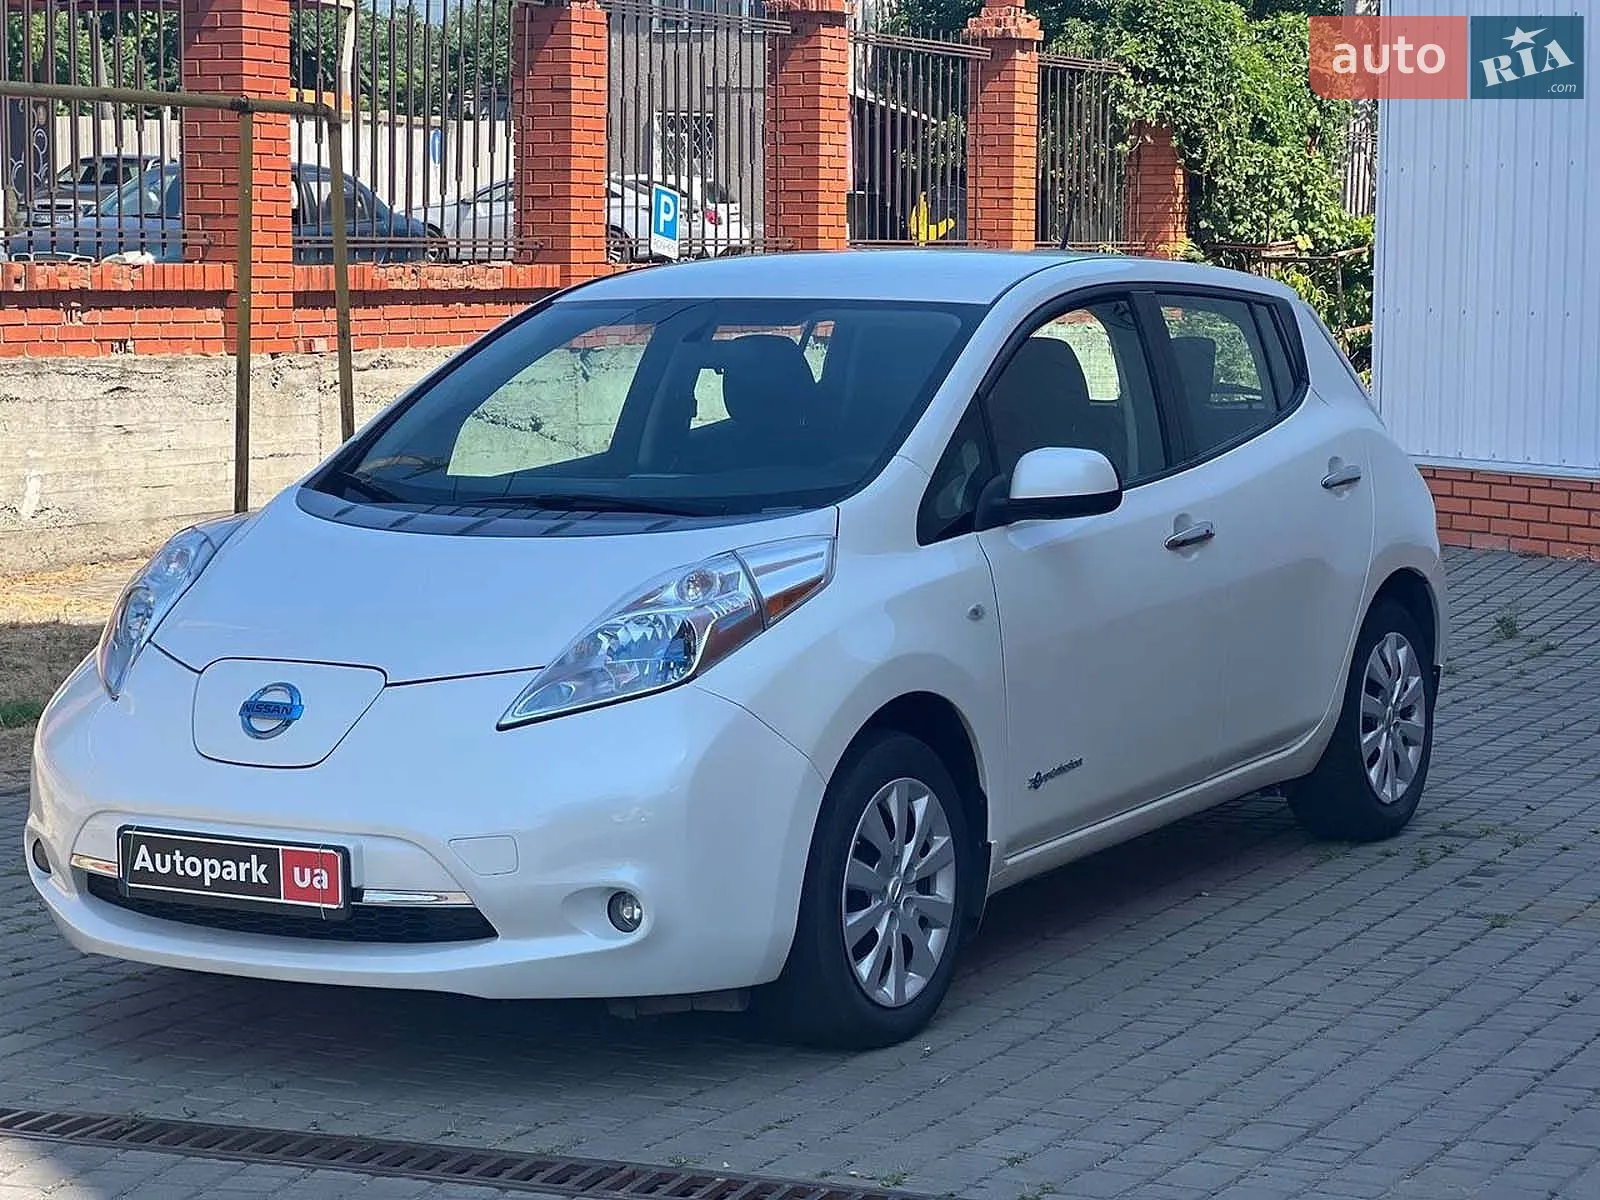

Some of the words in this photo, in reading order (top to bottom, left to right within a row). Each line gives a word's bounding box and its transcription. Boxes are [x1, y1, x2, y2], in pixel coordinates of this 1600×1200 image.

[660, 194, 675, 233] P
[242, 702, 293, 715] NISSAN
[133, 844, 269, 886] Autopark
[293, 865, 329, 890] ua
